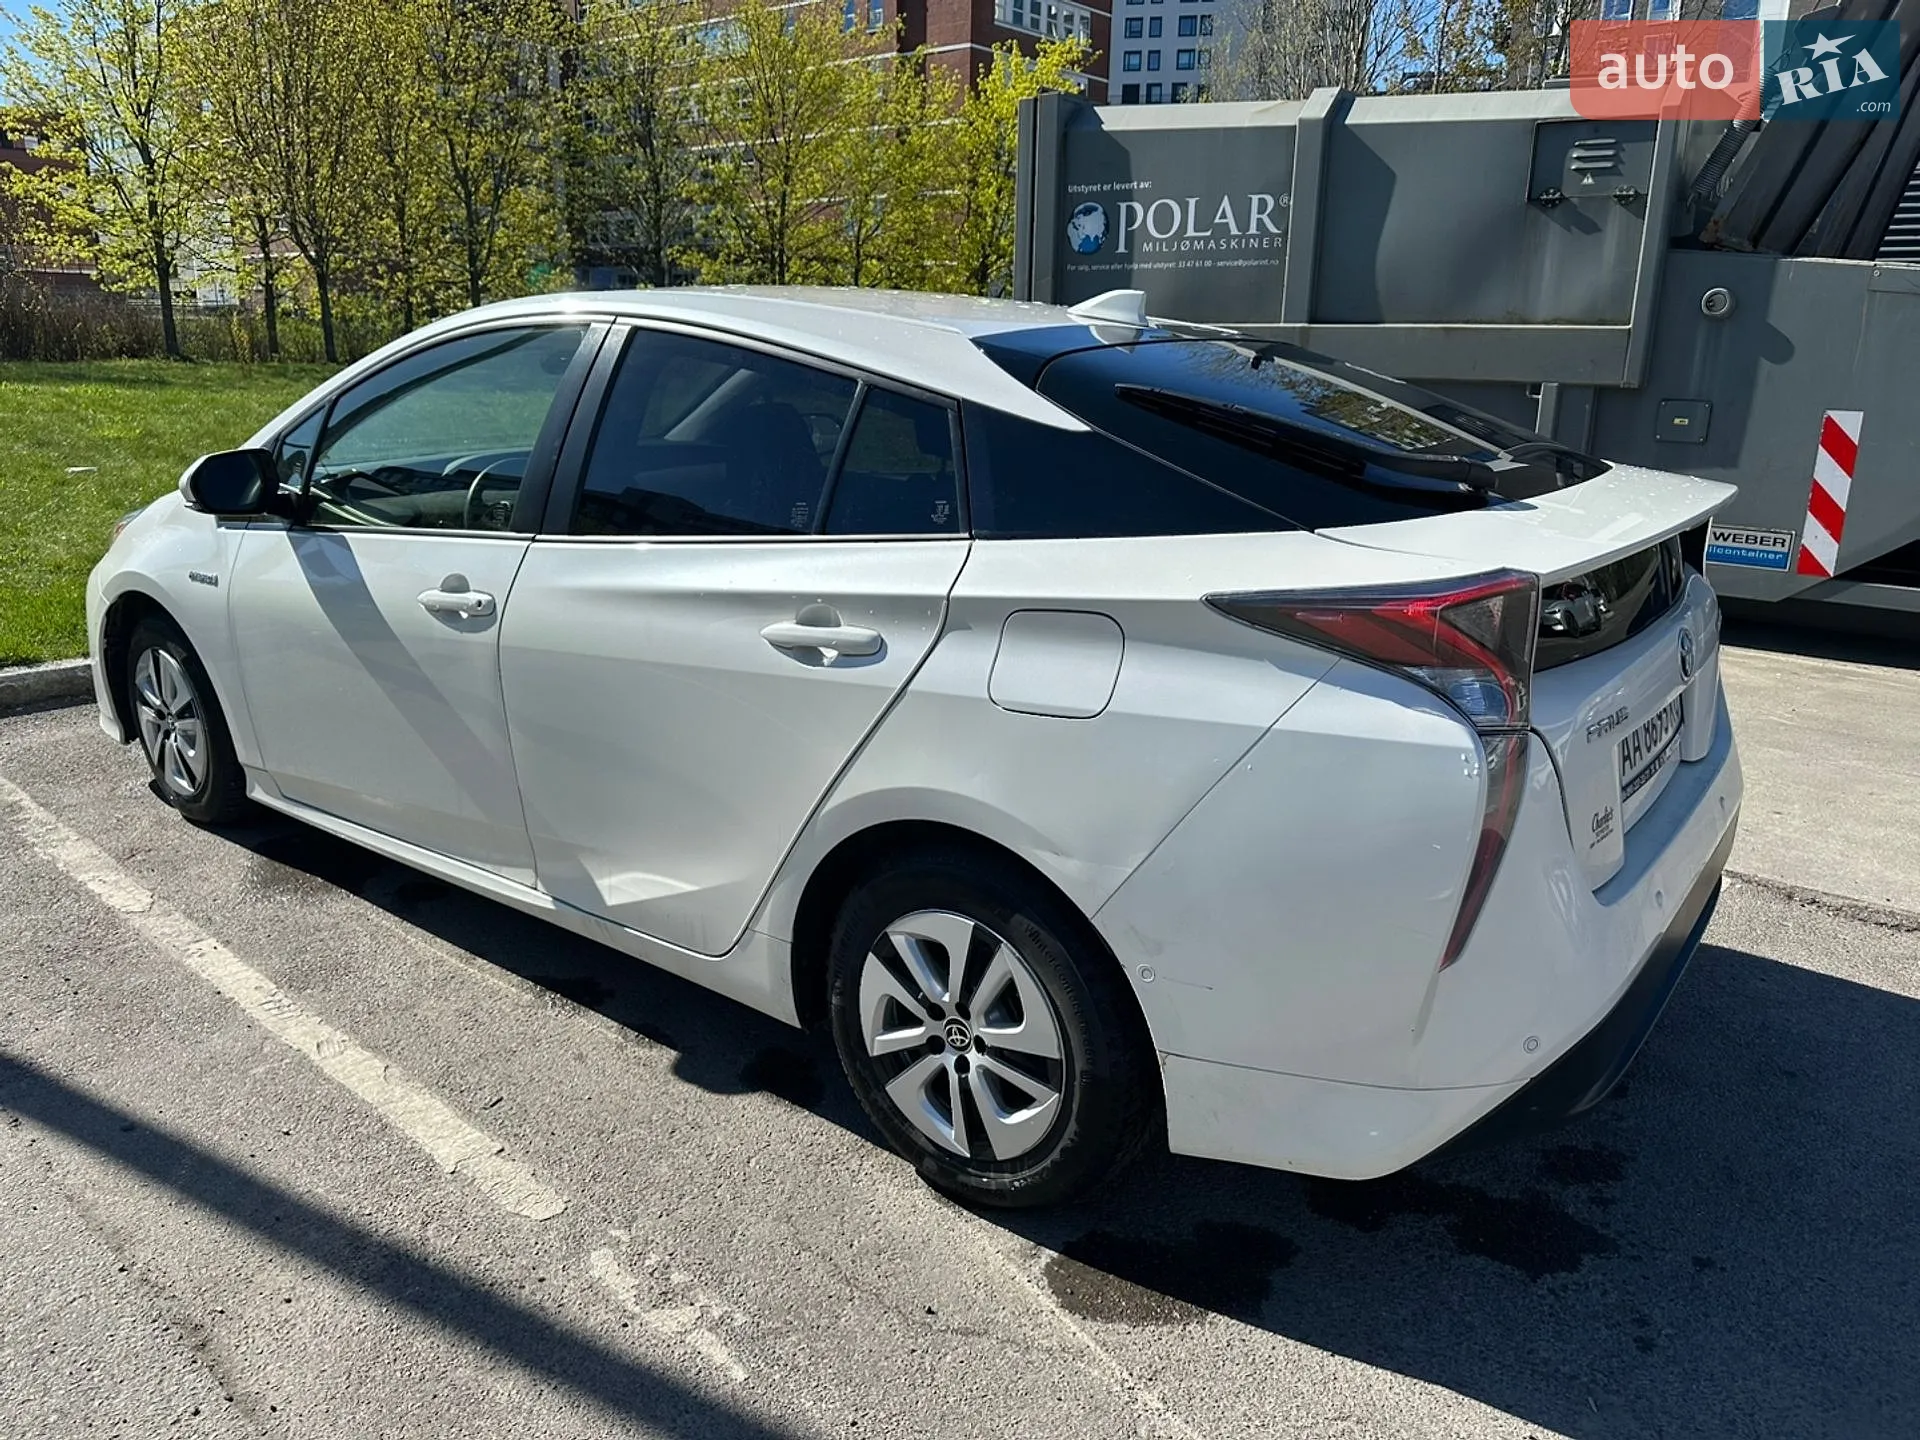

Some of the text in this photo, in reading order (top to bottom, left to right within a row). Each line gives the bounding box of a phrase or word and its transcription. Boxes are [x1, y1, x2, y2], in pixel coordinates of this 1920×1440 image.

[1068, 181, 1152, 194] Utstyret er levert av:
[1143, 237, 1283, 253] MILJØMASKINER
[1712, 531, 1787, 548] WEBER
[1622, 729, 1643, 777] AA
